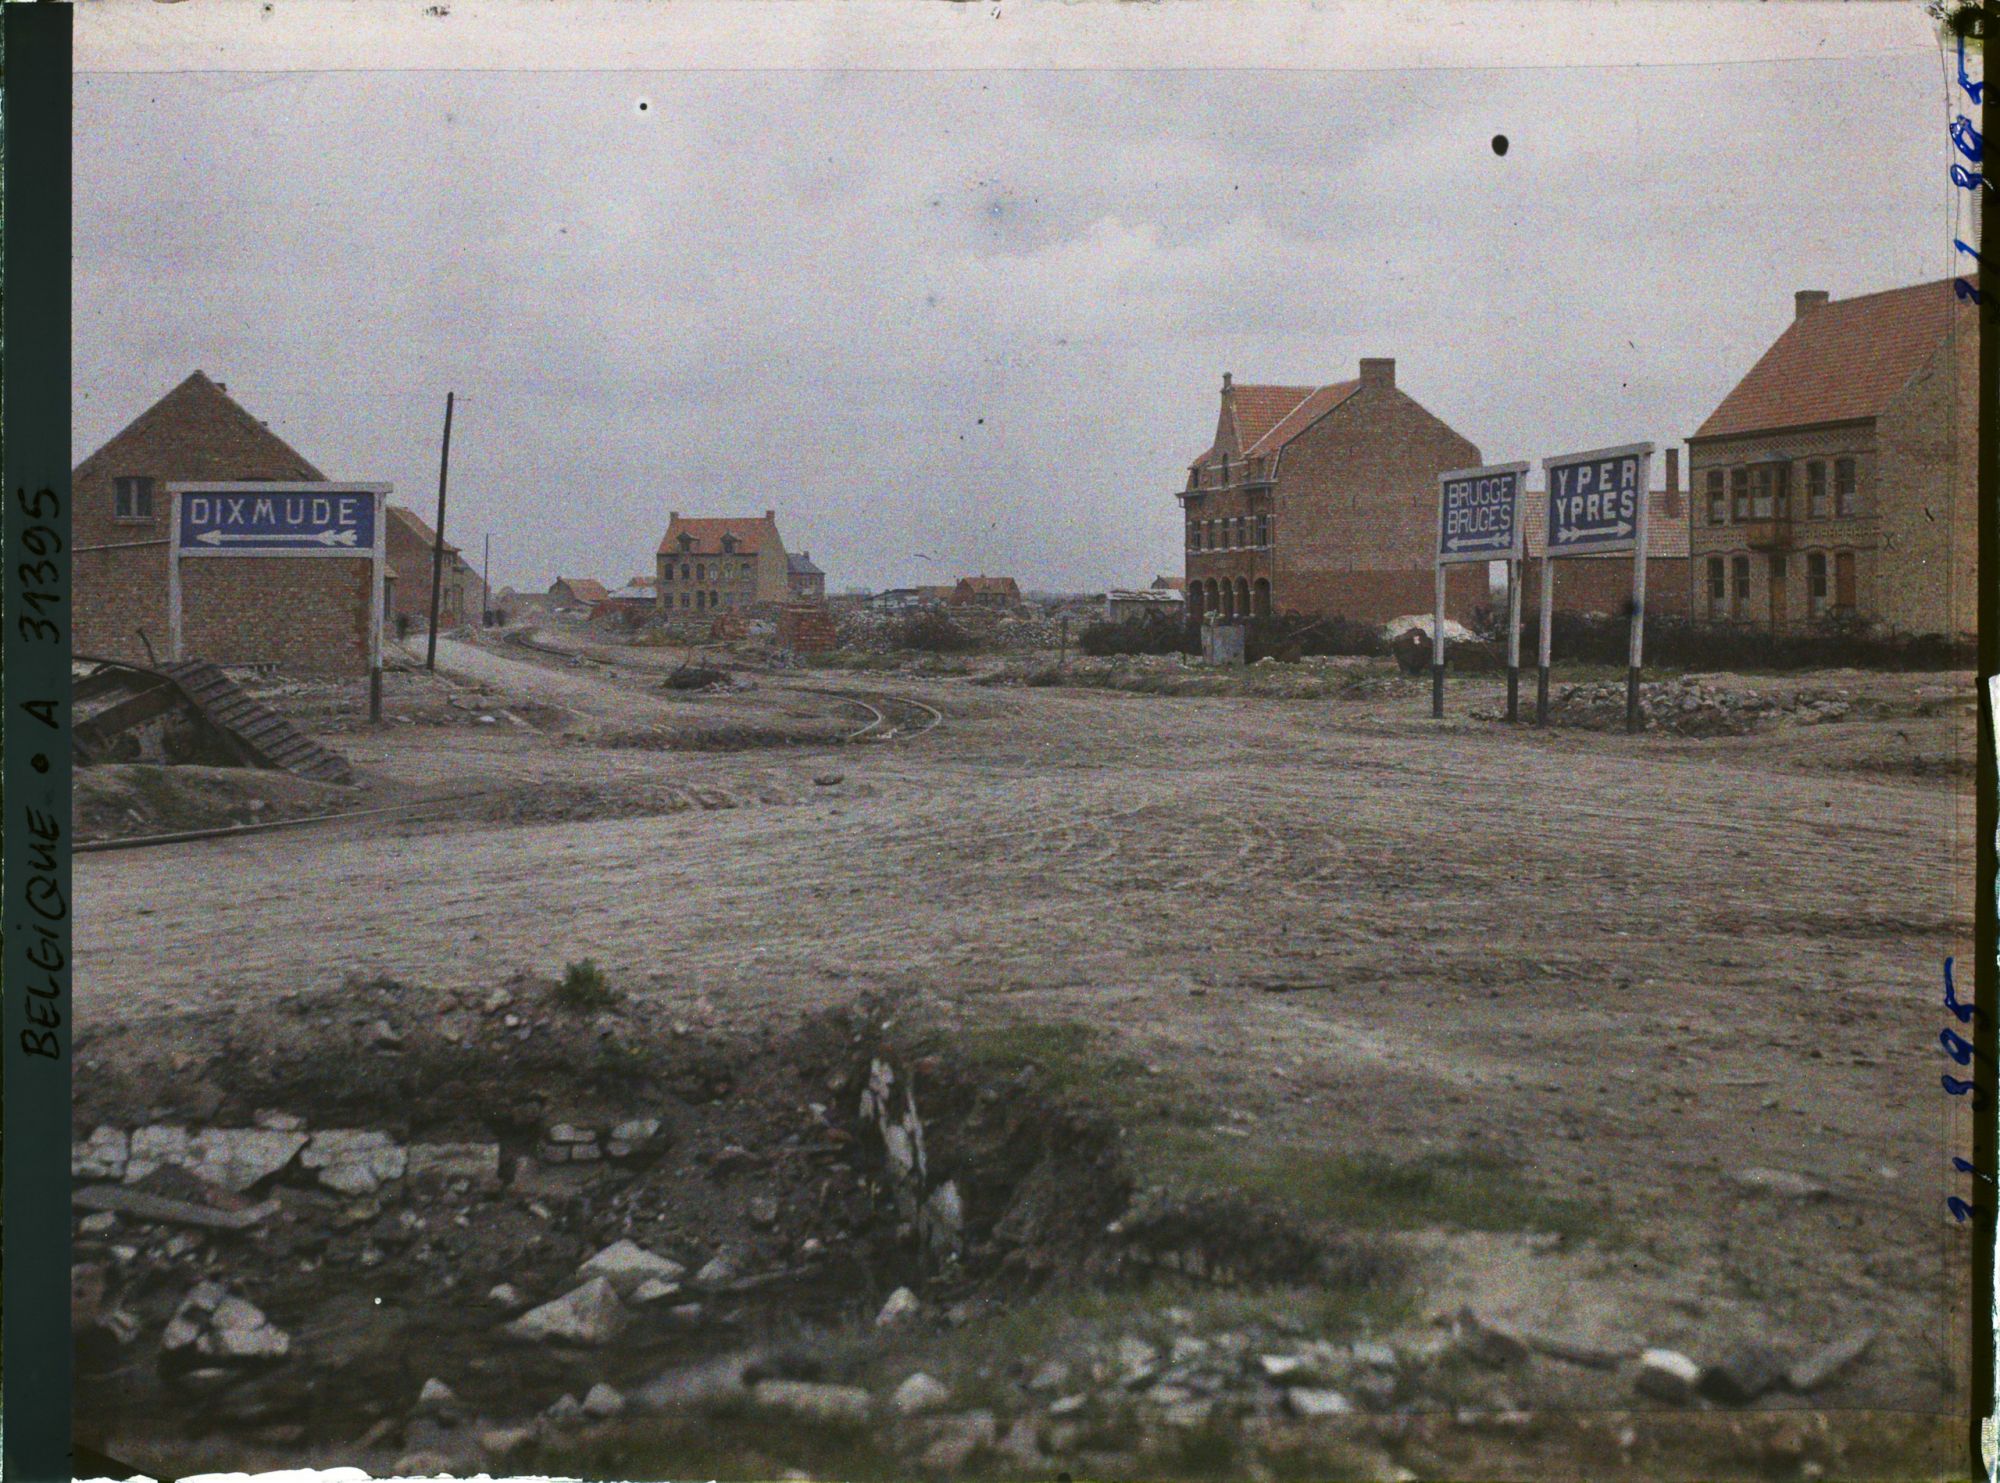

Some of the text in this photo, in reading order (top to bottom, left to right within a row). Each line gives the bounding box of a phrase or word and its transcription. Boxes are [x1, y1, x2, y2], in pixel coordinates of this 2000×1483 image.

[1448, 476, 1513, 508] BRUGGE
[1557, 459, 1637, 496] YPER
[190, 498, 358, 525] DIXMUDE
[1447, 504, 1512, 535] BRUGES
[1555, 489, 1636, 526] YPRES
